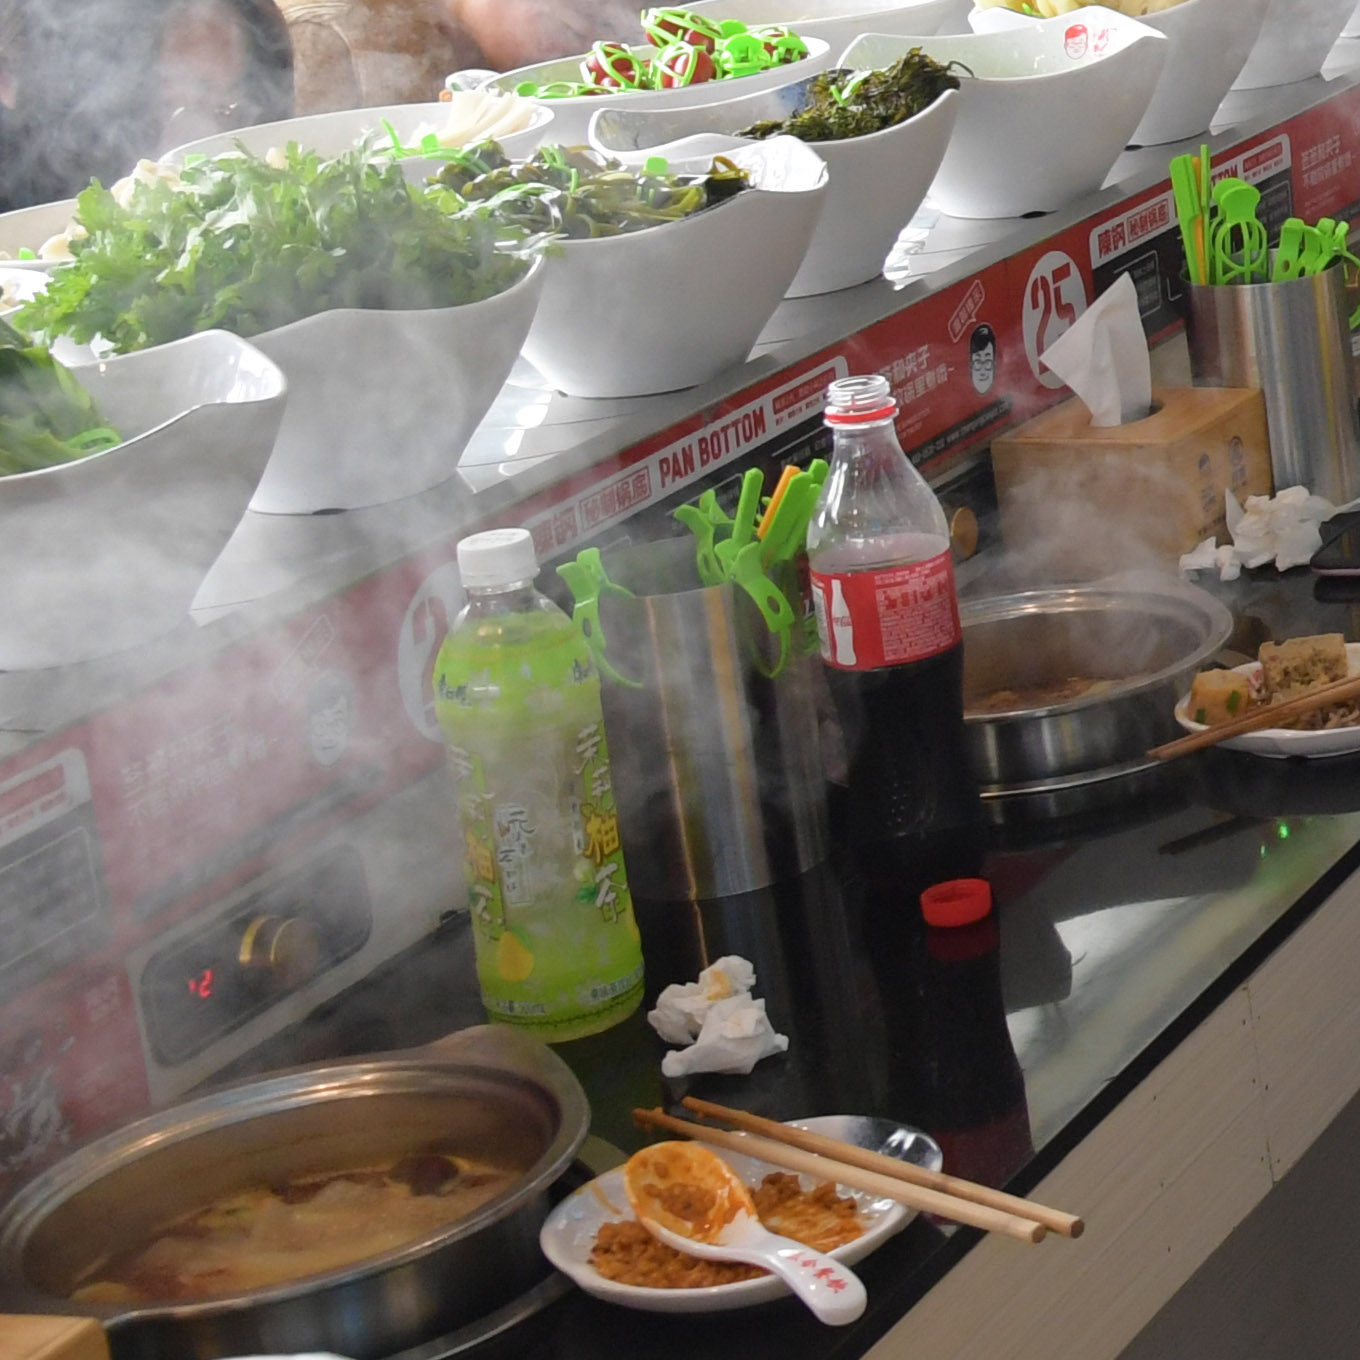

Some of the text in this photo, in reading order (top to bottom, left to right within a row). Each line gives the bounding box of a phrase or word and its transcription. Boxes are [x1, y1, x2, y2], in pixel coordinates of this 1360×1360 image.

[1031, 261, 1076, 377] 25
[659, 444, 696, 489] PAN
[698, 405, 767, 467] BOTTOM
